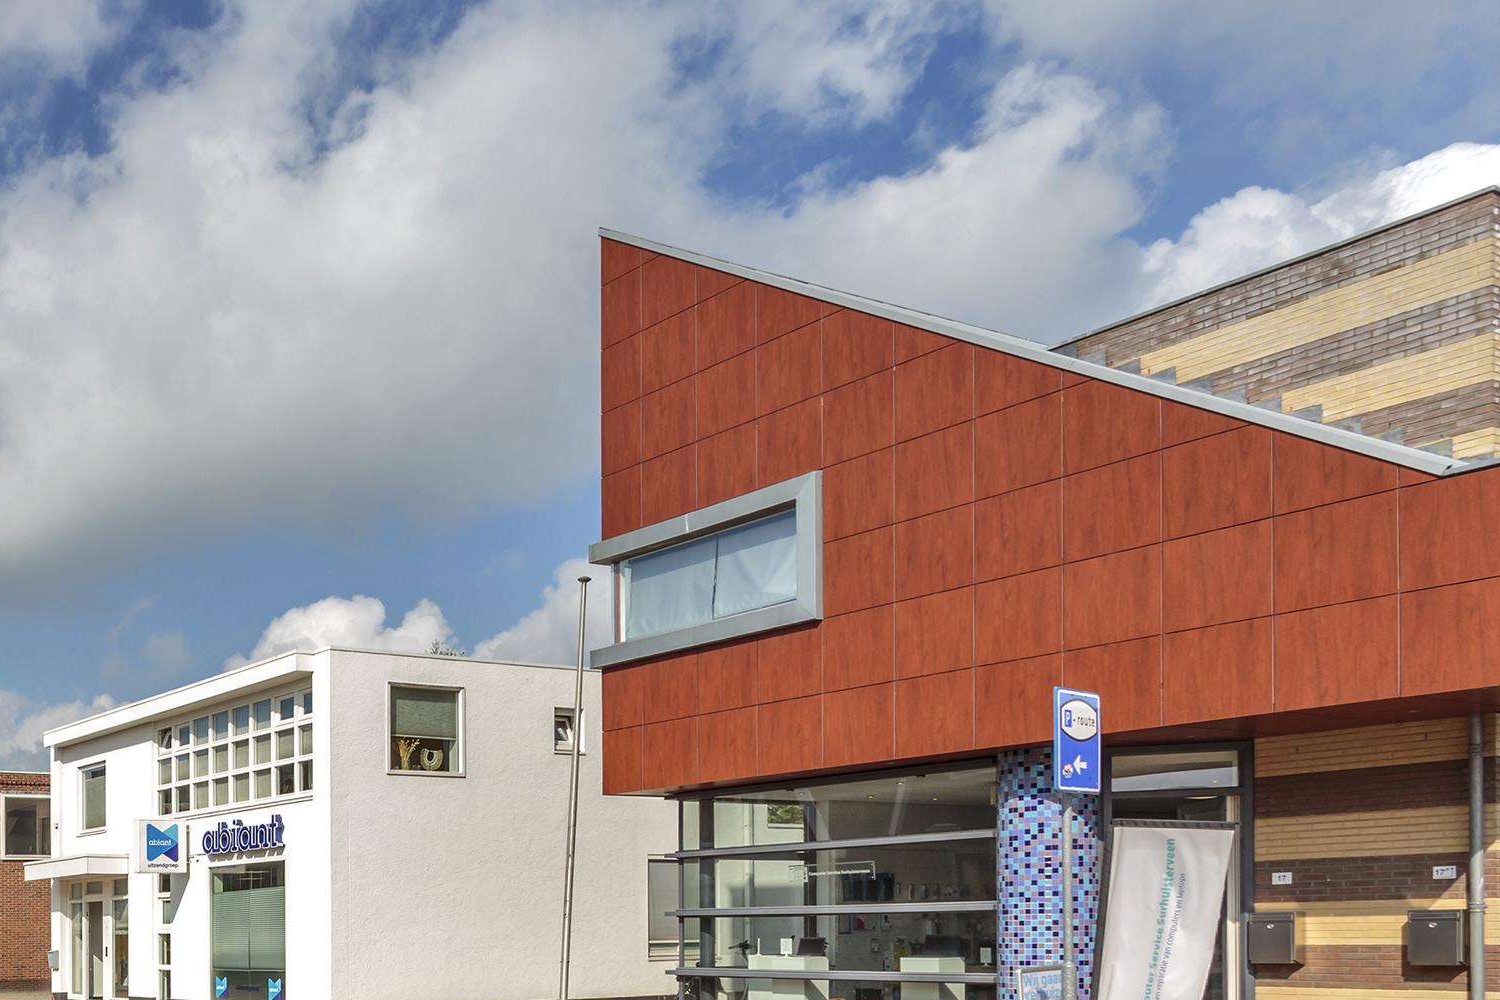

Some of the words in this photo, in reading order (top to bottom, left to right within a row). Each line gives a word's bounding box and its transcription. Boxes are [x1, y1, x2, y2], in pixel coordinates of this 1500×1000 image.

[148, 838, 172, 846] abiant
[202, 814, 285, 855] abiant
[1156, 838, 1177, 926] Surhuisterveen
[1176, 872, 1186, 899] laptops
[1166, 908, 1182, 946] computers
[1149, 928, 1164, 970] Service
[1164, 946, 1172, 960] van
[1024, 973, 1039, 988] Wij
[1155, 960, 1169, 991] reparatie
